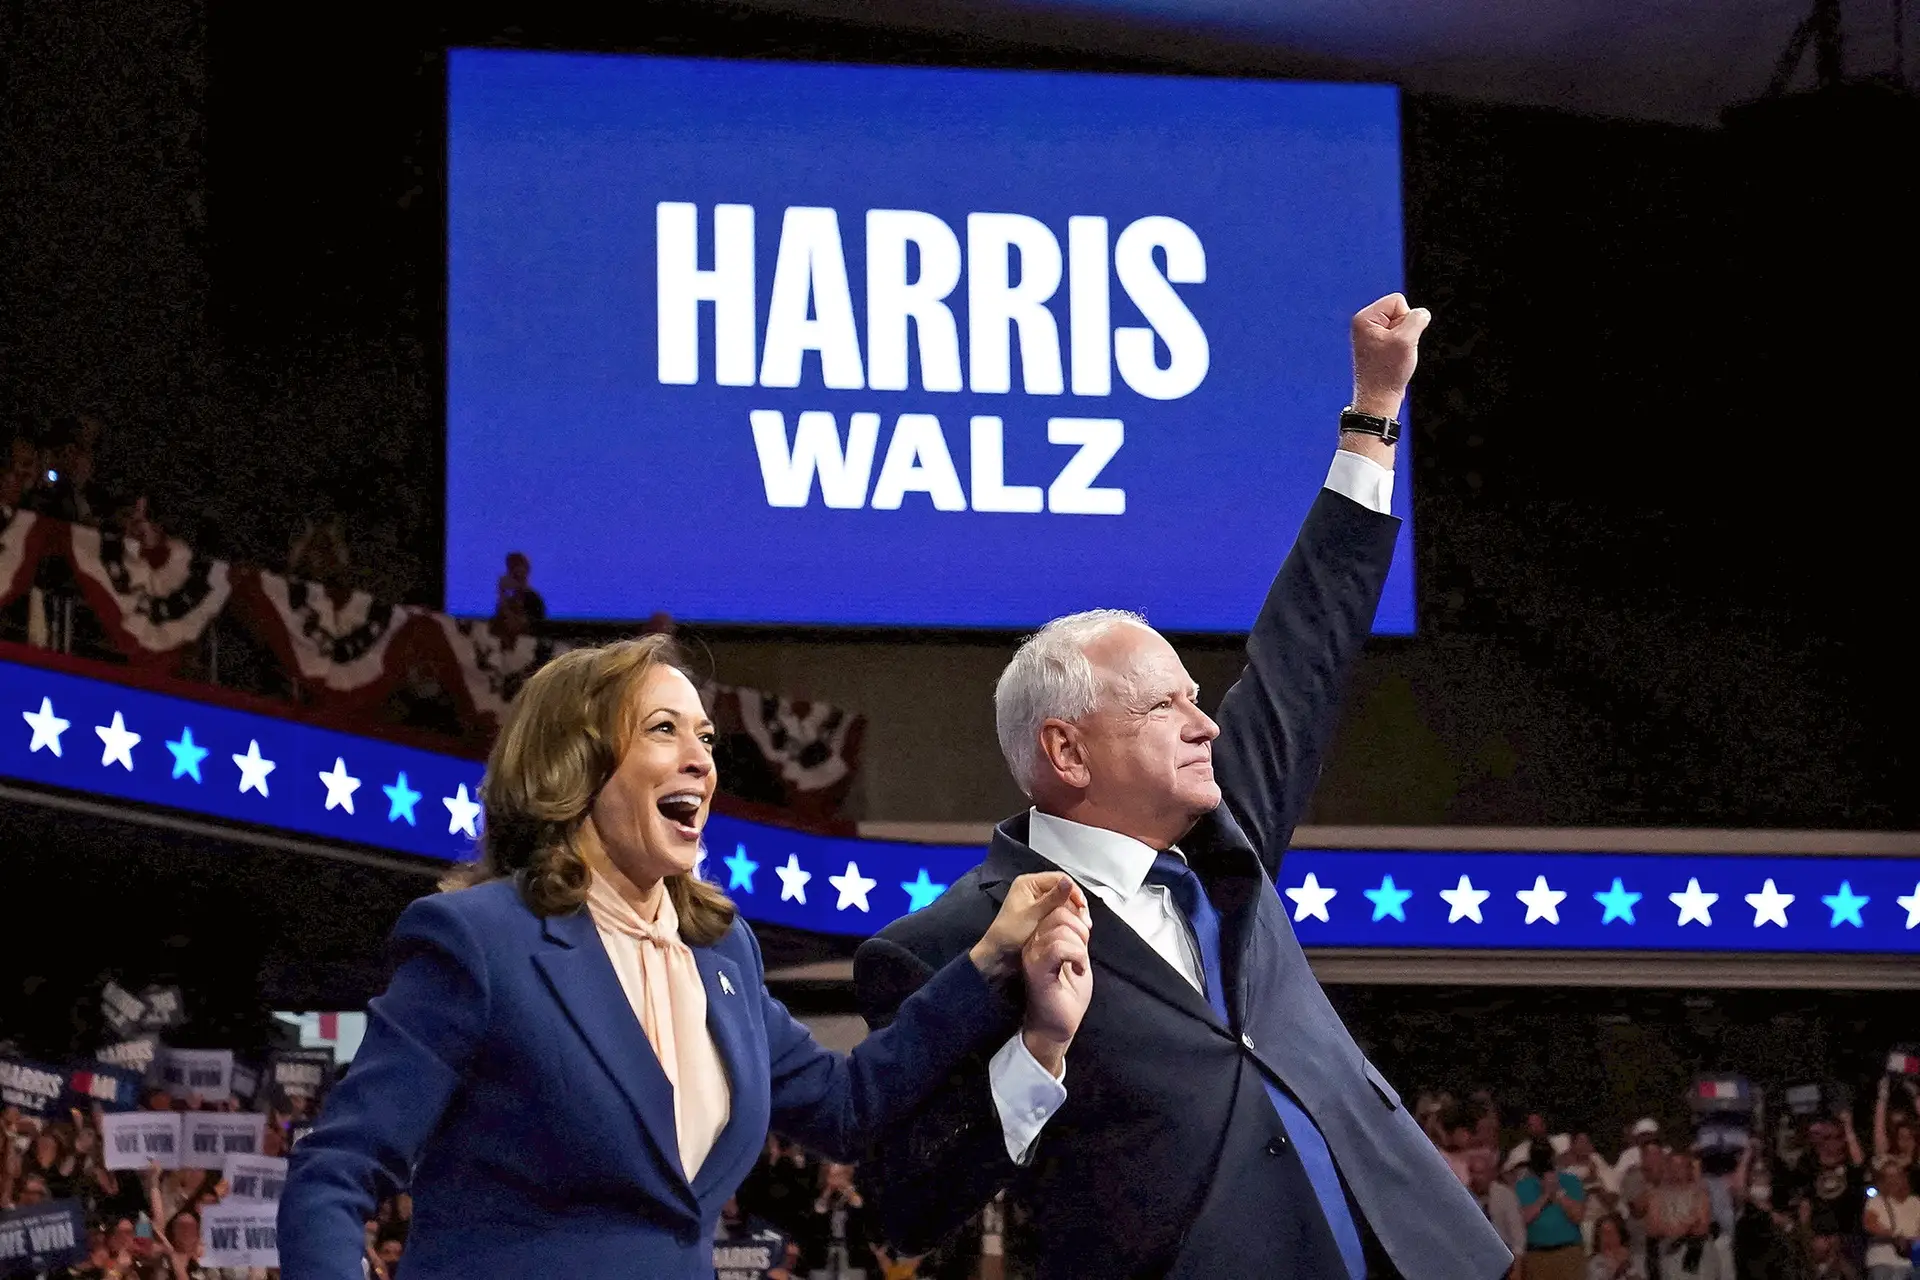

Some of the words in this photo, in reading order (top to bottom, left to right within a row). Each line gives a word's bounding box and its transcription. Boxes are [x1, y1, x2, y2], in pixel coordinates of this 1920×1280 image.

[656, 201, 1210, 401] HARRIS
[750, 409, 1126, 515] WALZ
[29, 1221, 76, 1253] WIN
[211, 1226, 239, 1250] WE
